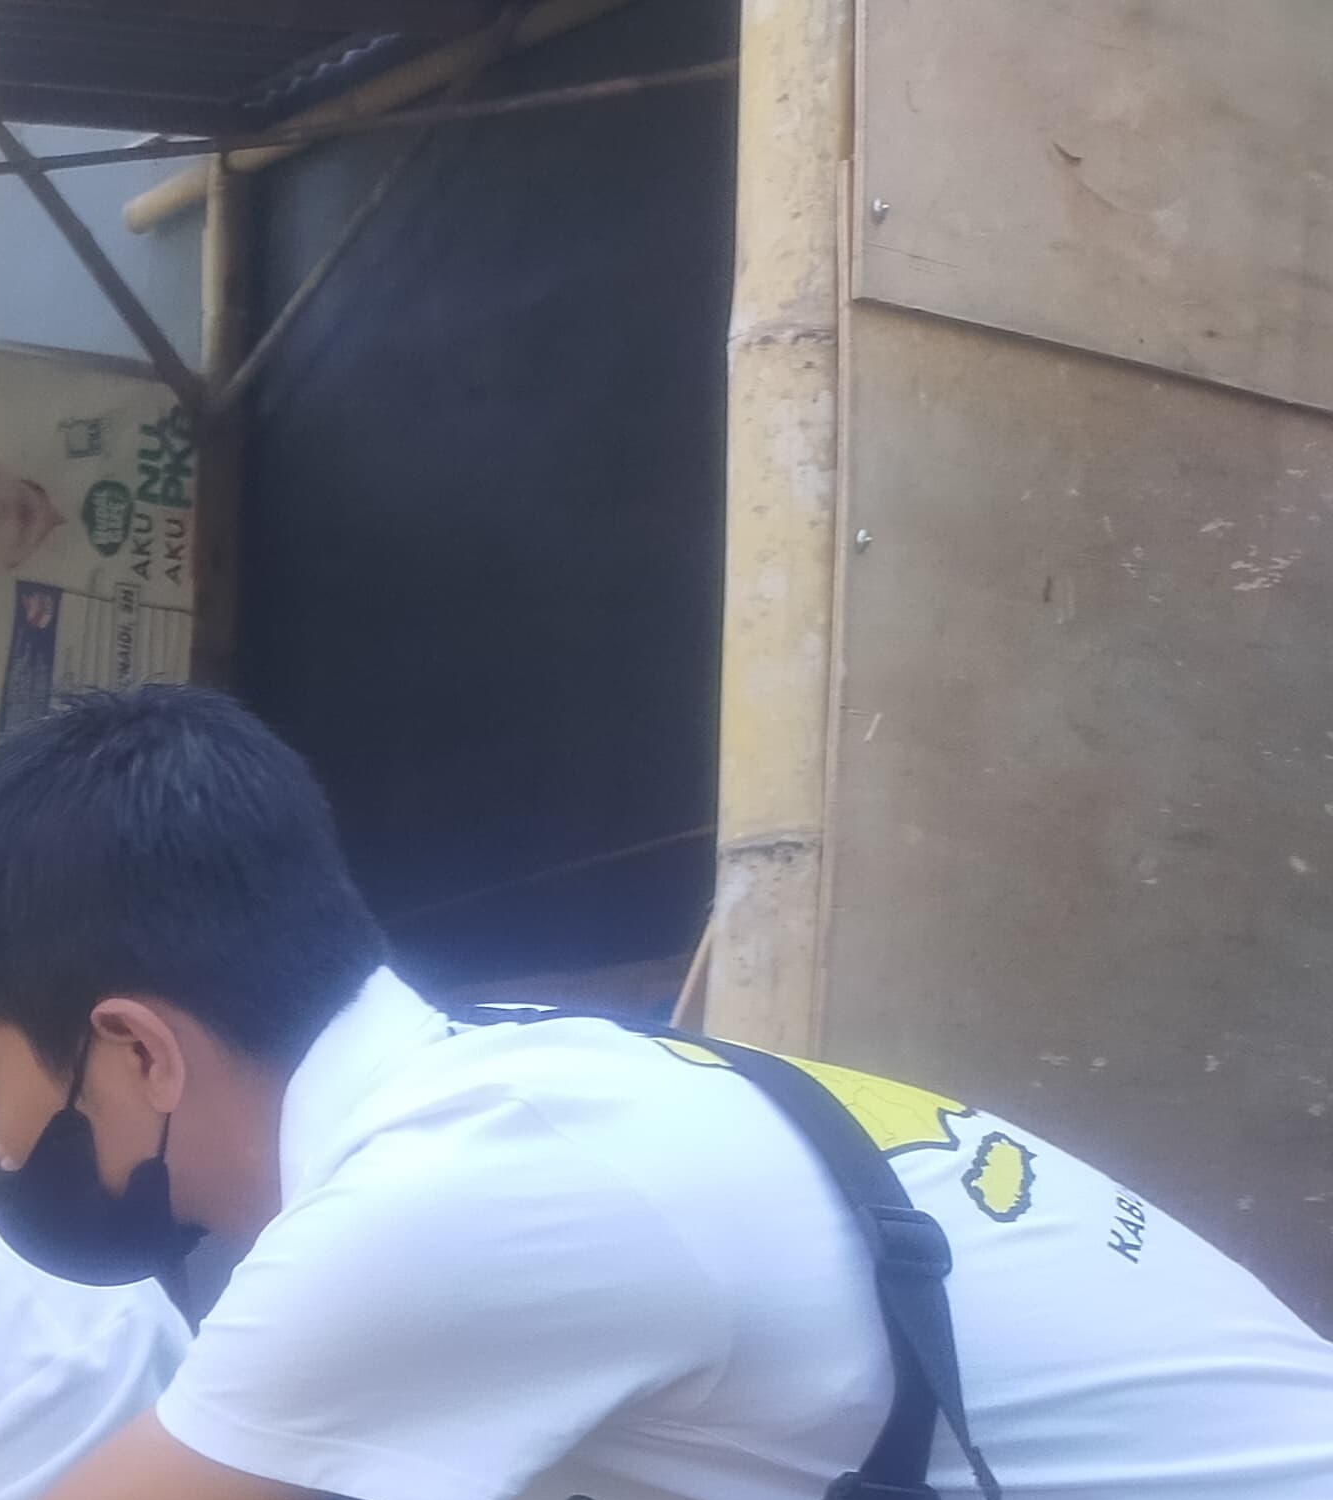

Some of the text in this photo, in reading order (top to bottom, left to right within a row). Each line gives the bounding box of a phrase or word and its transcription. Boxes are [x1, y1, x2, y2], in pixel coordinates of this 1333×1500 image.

[131, 512, 154, 581] AKU
[164, 518, 187, 587] AKU
[1107, 1190, 1145, 1264] KAB
